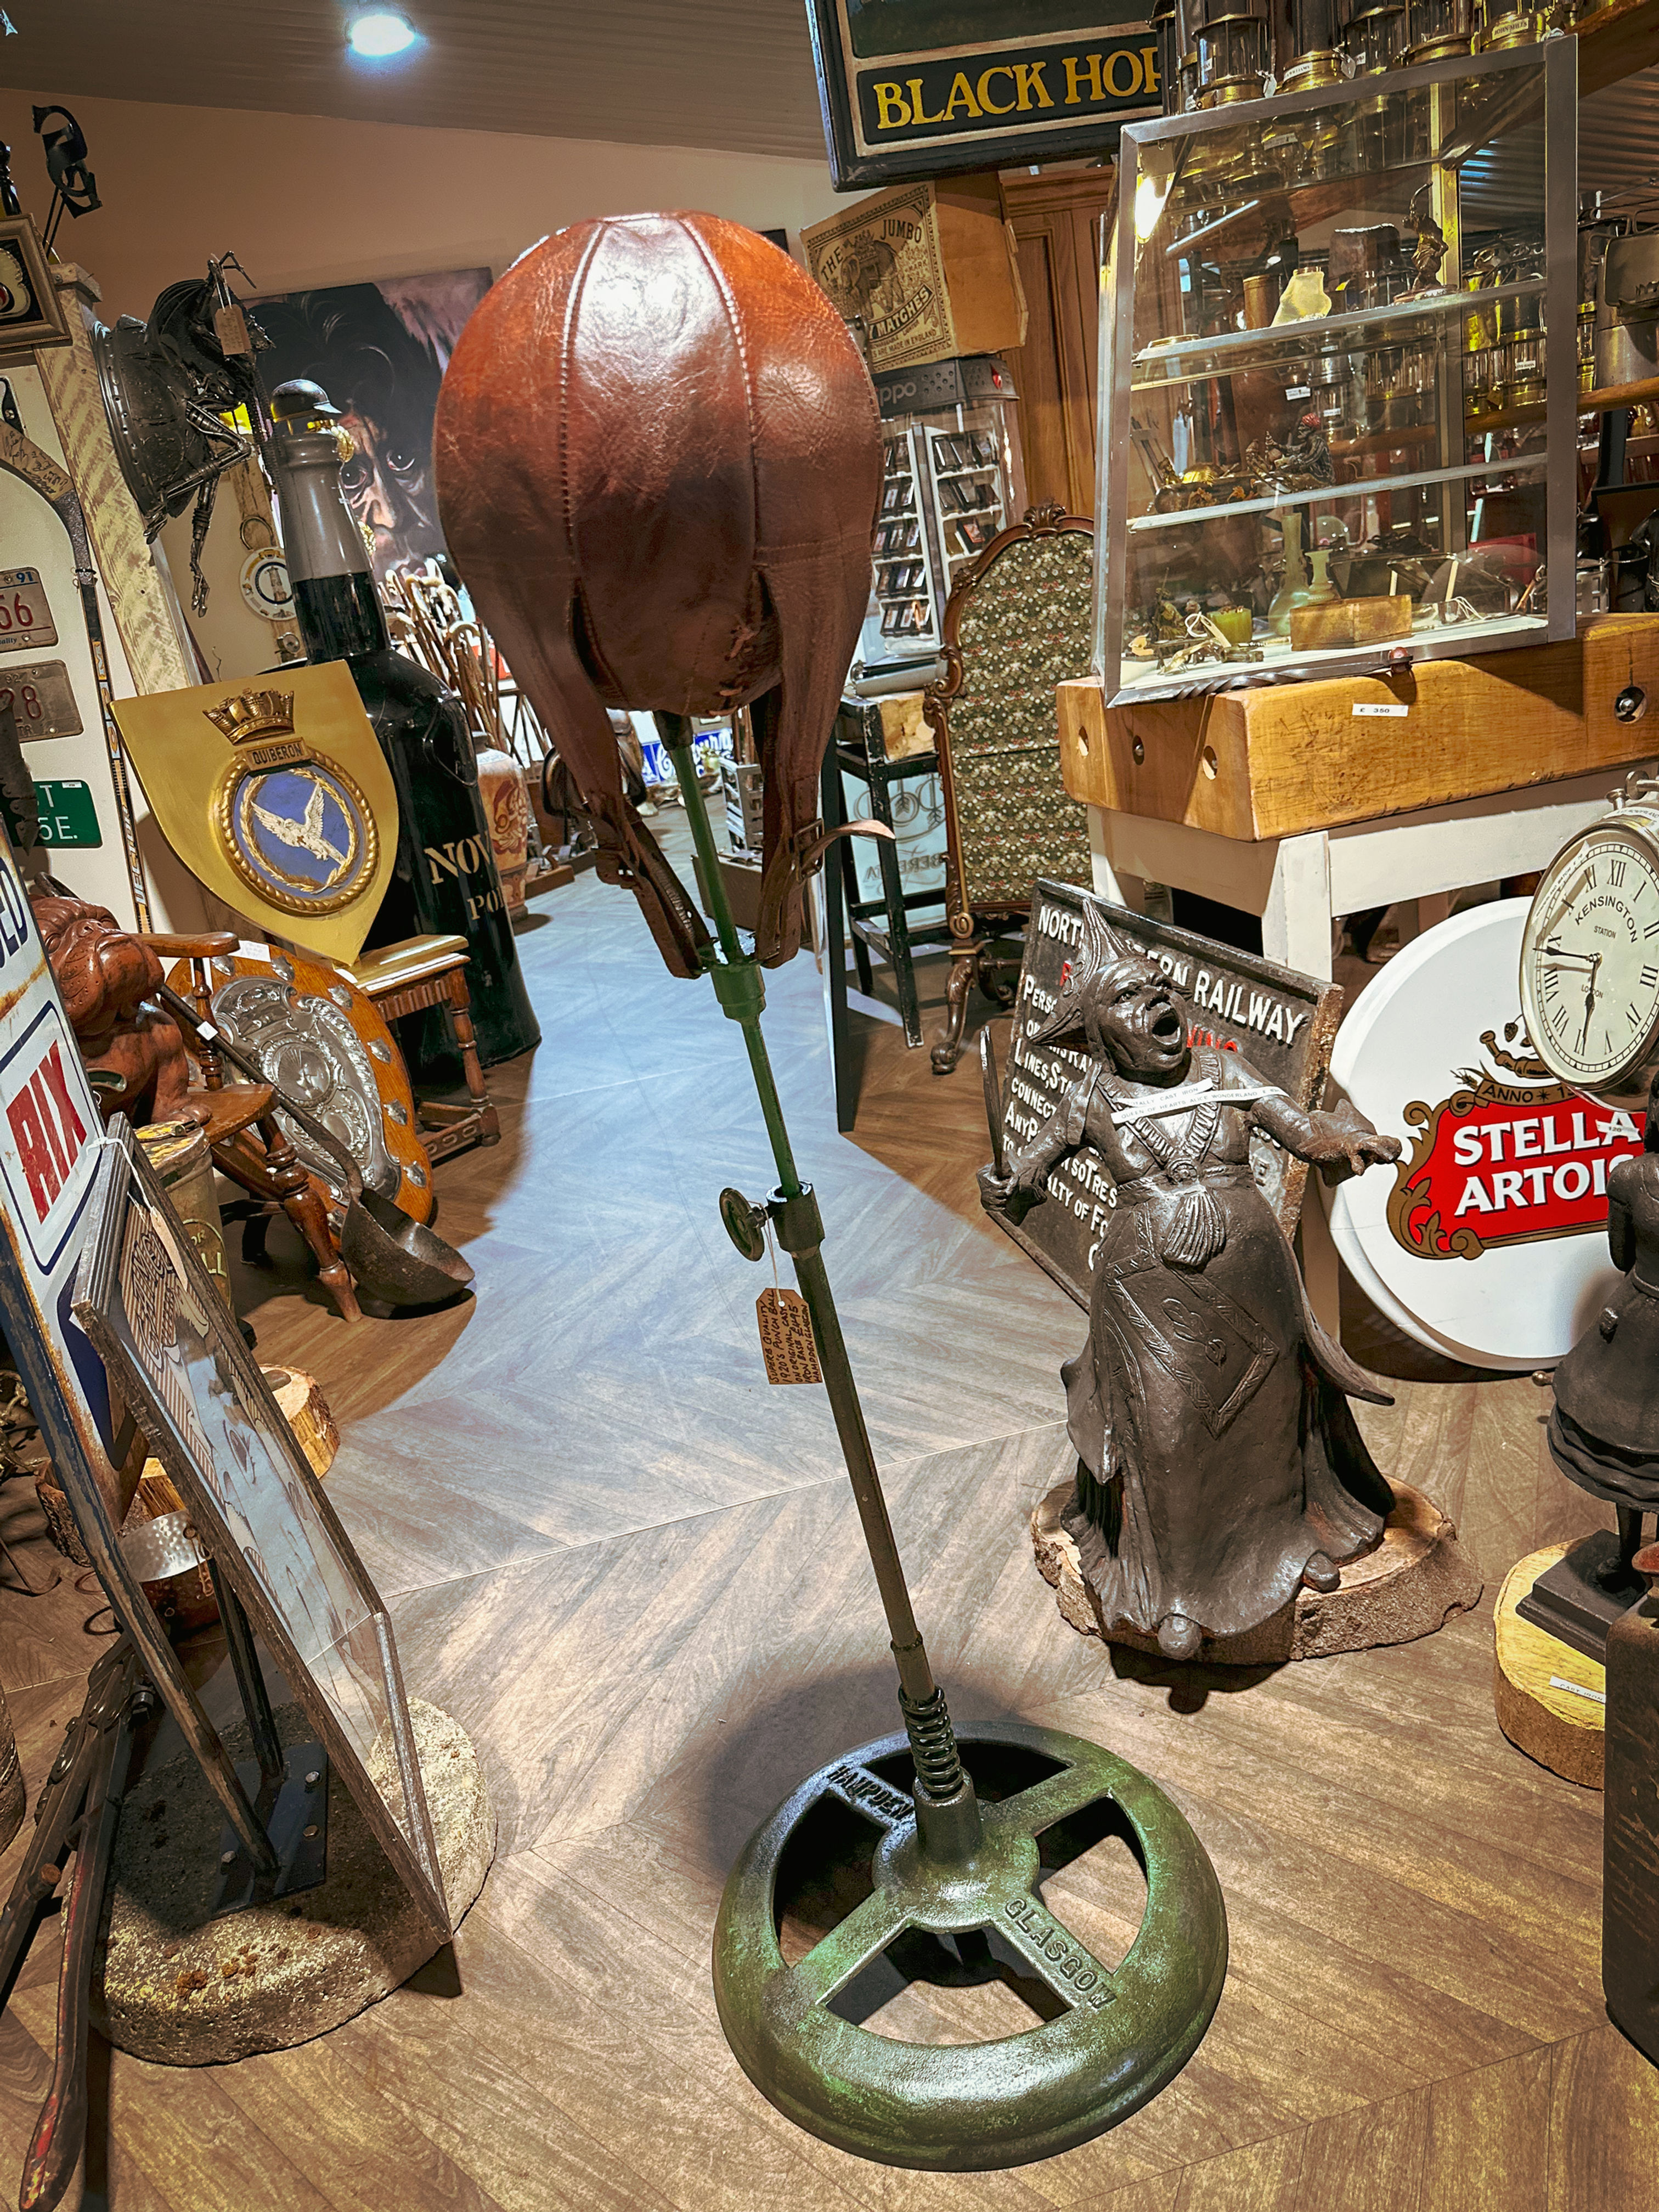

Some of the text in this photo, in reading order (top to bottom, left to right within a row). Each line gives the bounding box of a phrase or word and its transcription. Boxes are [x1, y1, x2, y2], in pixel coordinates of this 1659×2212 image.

[873, 61, 1054, 129] BLACK
[821, 219, 922, 281] THE JUMBO
[877, 286, 930, 338] MATCHES
[911, 329, 936, 345] ENGLAND
[16, 572, 34, 583] 91
[252, 742, 303, 765] QUIBERON
[1607, 859, 1627, 888] XII
[1575, 895, 1638, 944] KENSINGTON
[1593, 925, 1617, 939] STATION
[1194, 970, 1306, 1043] RAILWAY
[1121, 1109, 1144, 1119] QUEEN
[1160, 1101, 1187, 1110] HEARTS
[1160, 1093, 1177, 1102] CAST
[1182, 1087, 1199, 1096] IRON
[1482, 1085, 1534, 1103] ANNO
[6, 1039, 87, 1225] RIX
[1005, 1101, 1030, 1137] ANY
[1453, 1111, 1642, 1166] STELLA
[1085, 1158, 1118, 1208] TRES
[1074, 1199, 1090, 1221] OF
[766, 1289, 793, 1383] 1920'S PUNCH BALL
[780, 1306, 804, 1383] ON ORIGINAL CAST
[765, 1348, 780, 1383] SUPERB
[800, 1363, 812, 1384] IRON
[805, 1339, 822, 1383] HAMPDEN
[826, 1765, 915, 1821] HAMPDEN
[1005, 1898, 1118, 2009] GLASGOW
